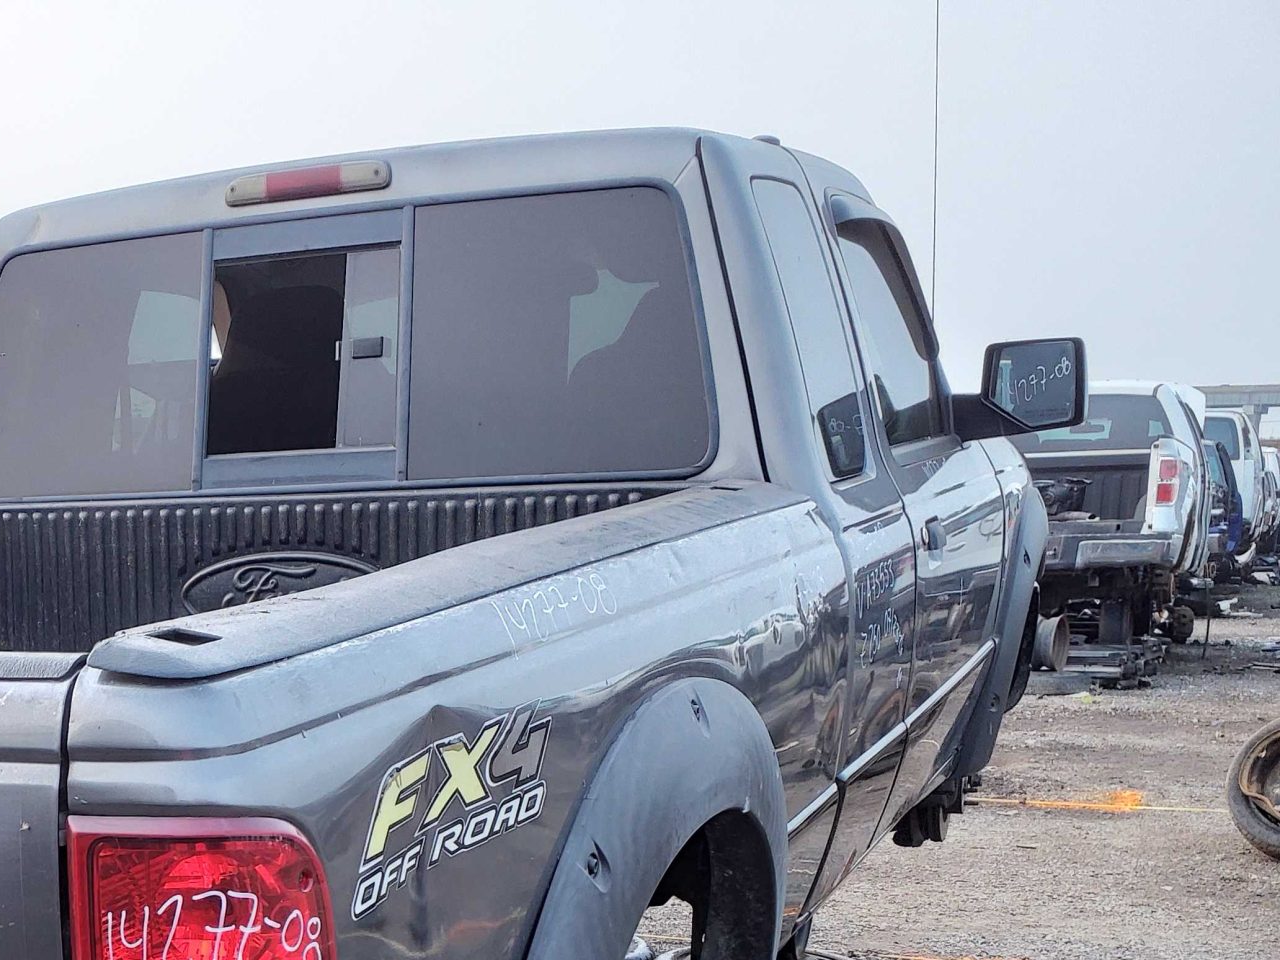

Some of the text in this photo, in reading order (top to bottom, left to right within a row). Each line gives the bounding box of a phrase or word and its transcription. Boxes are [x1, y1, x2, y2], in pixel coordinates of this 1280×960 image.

[490, 572, 618, 660] 14277-08
[352, 781, 546, 918] OFF ROAD
[361, 699, 552, 872] FX4
